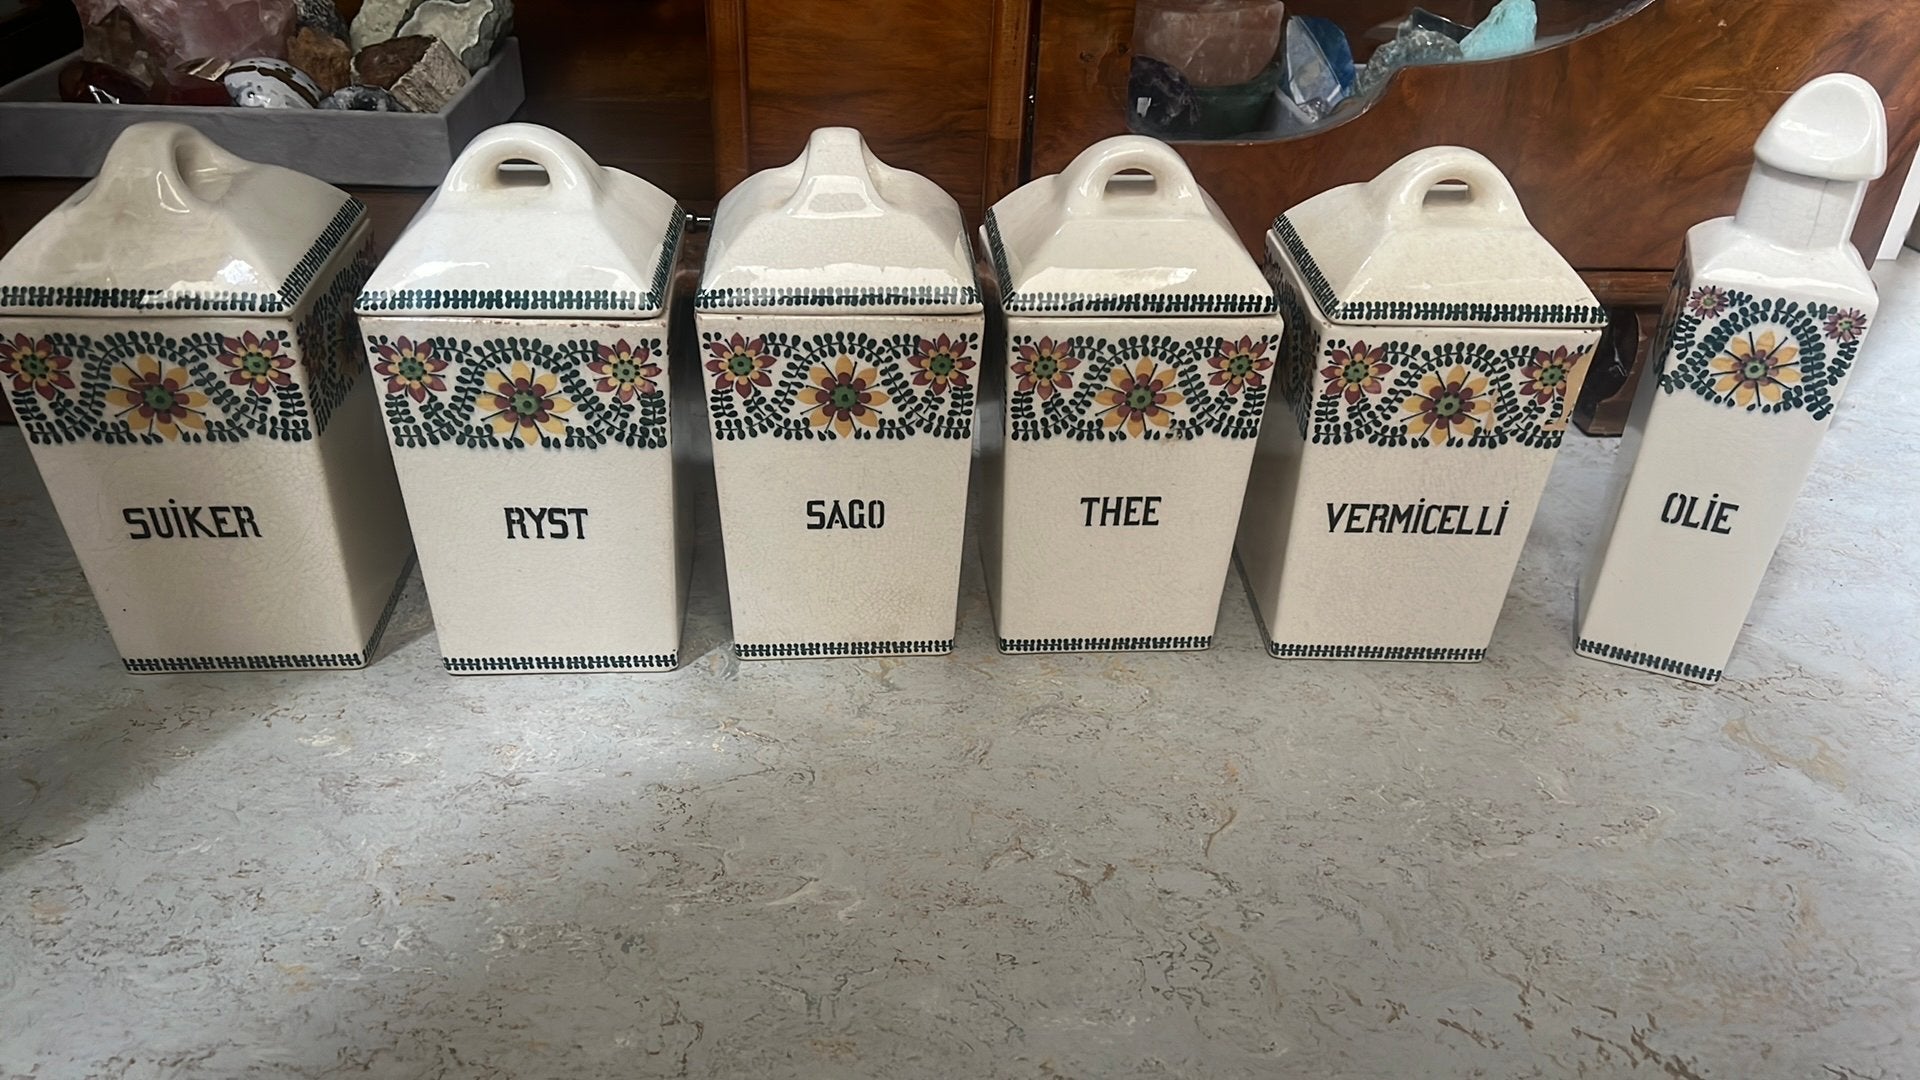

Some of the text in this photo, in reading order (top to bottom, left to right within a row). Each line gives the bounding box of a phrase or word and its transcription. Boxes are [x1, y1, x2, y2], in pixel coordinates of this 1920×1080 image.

[503, 507, 589, 540] RYST
[806, 499, 885, 530] SAGO
[1080, 496, 1162, 527] THEE
